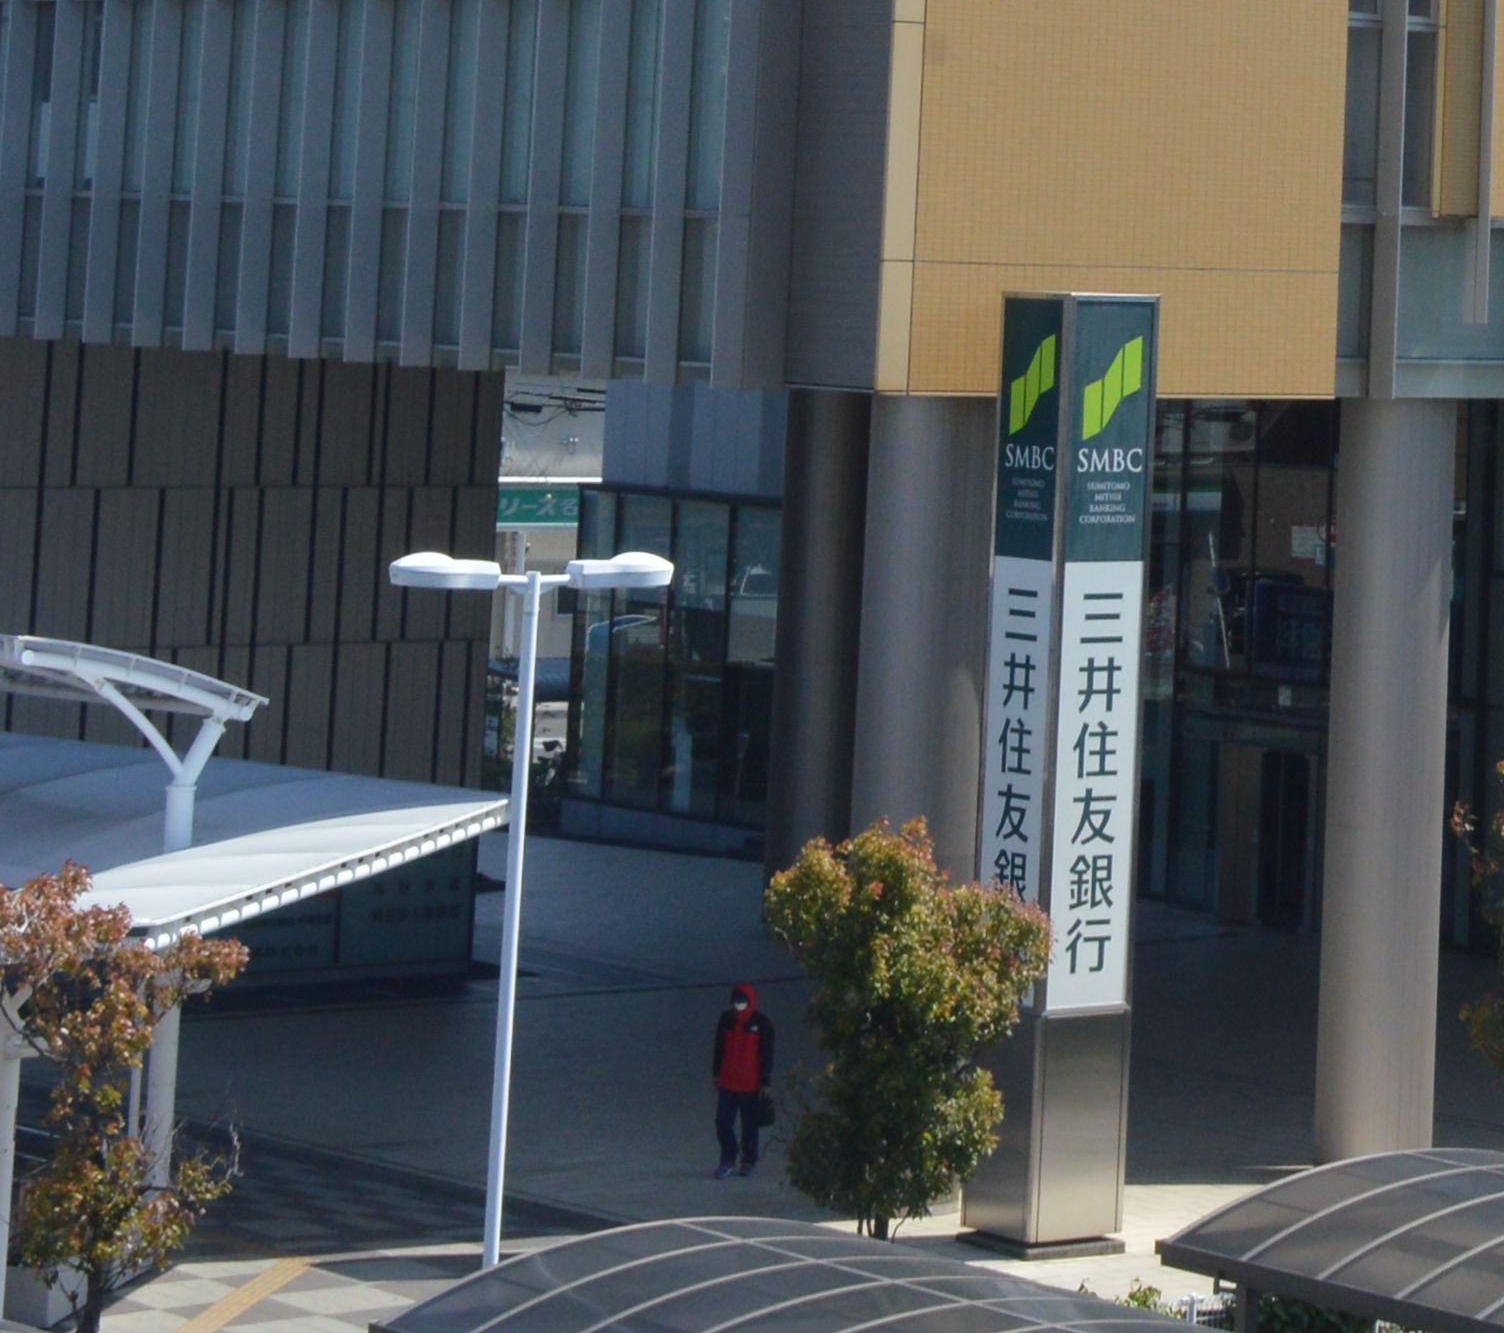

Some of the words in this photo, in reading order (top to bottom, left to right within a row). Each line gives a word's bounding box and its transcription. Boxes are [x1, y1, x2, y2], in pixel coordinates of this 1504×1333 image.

[1005, 443, 1055, 470] SMBC
[1077, 448, 1143, 473] SMBC
[994, 587, 1039, 901] 三井住友銀
[1065, 592, 1124, 975] 三井住友銀行
